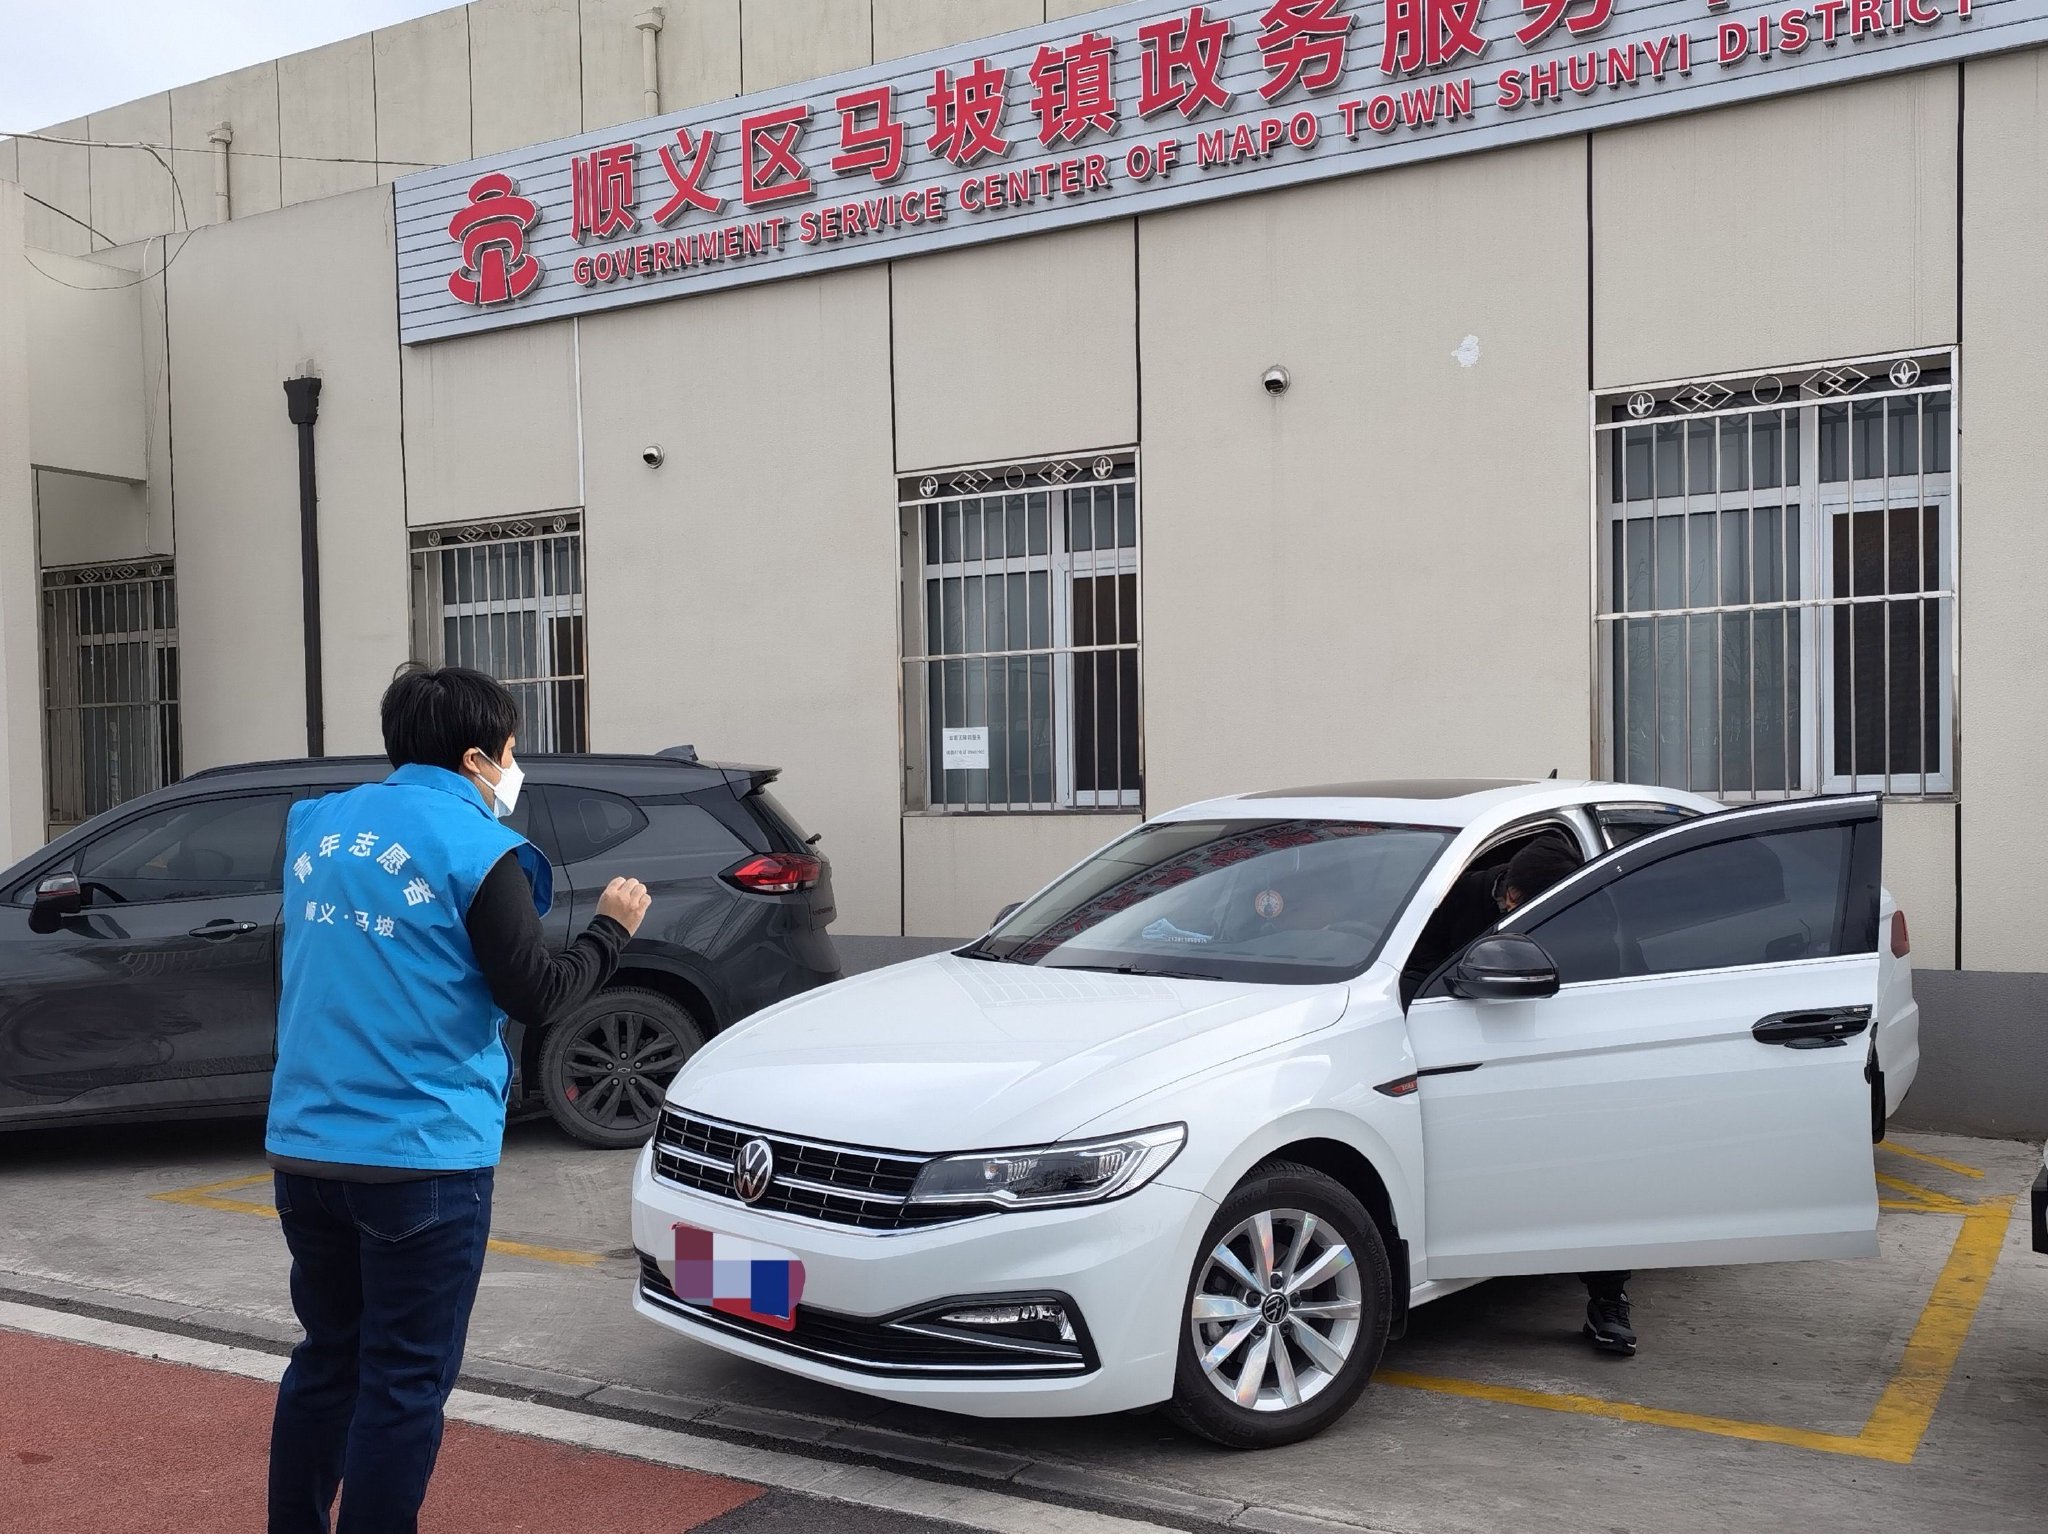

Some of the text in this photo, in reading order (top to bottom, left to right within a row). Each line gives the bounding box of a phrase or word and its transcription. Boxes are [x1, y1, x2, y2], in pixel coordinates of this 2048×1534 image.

[571, 0, 1723, 245] 顺义区马坡镇政务服
[573, 216, 786, 286] GOVERNMENT
[799, 186, 942, 243] SERVICE
[960, 154, 1106, 211] CENTER
[1126, 139, 1177, 179] OF
[1197, 111, 1317, 167] MAPO
[1338, 78, 1472, 137] TOWN
[1496, 32, 1690, 108] SHUNYI
[293, 831, 435, 907] 青年志愿者
